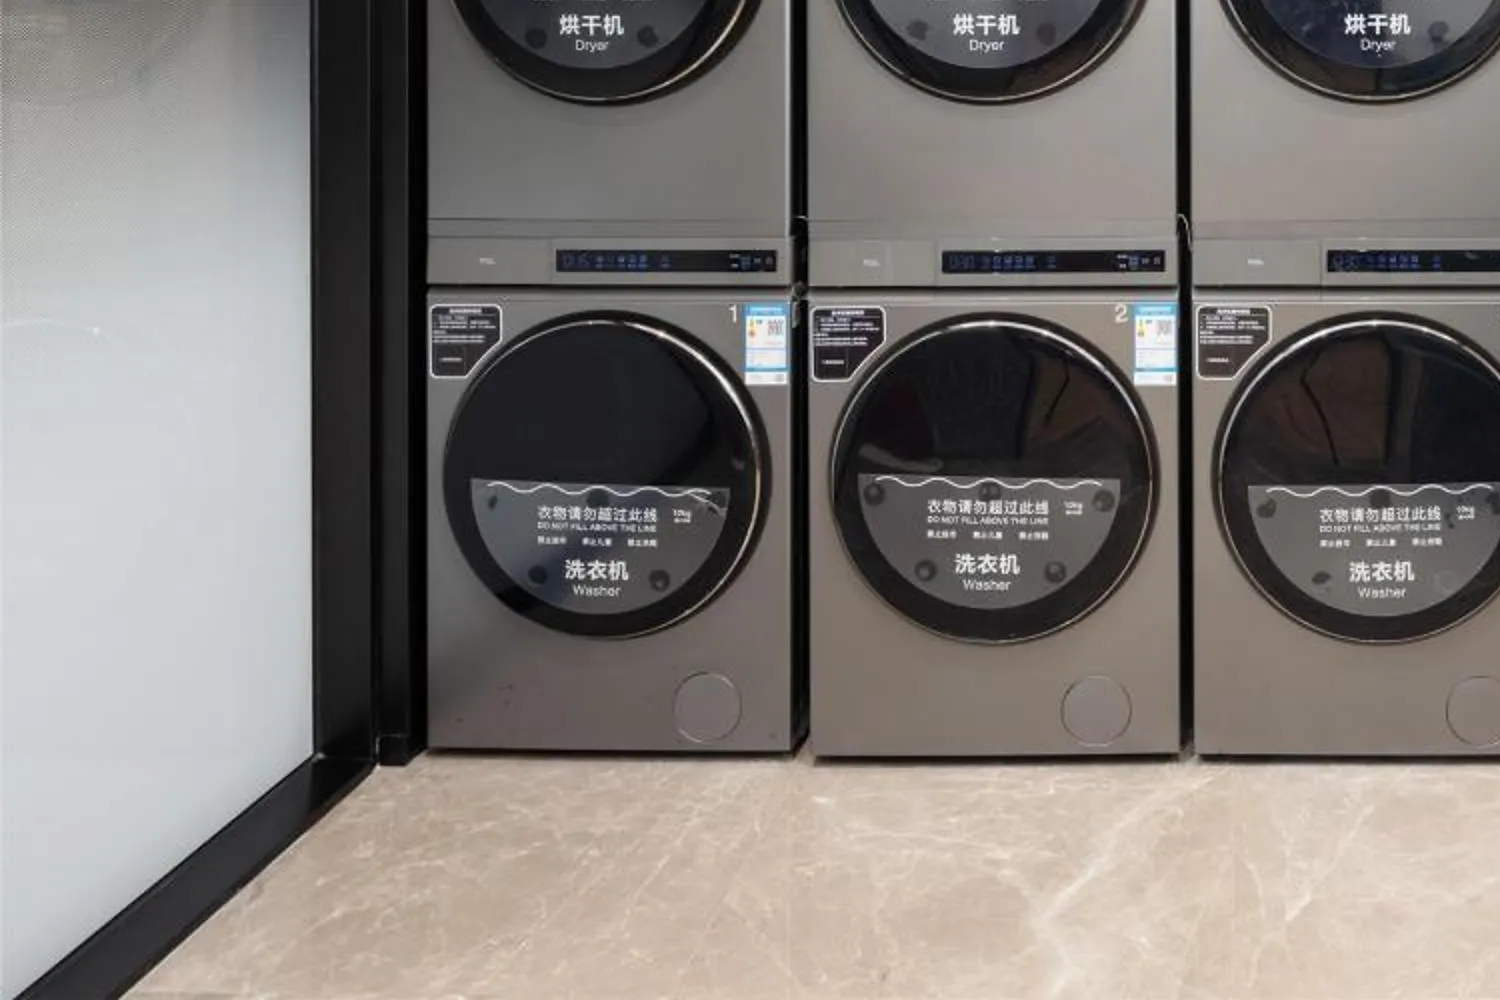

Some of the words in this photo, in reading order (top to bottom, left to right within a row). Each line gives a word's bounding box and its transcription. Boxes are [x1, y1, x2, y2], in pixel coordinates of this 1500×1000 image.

[560, 14, 624, 36] 烘干机
[952, 13, 1020, 36] 烘干机
[1344, 13, 1411, 35] 烘干机
[576, 40, 608, 52] Dryer
[970, 39, 1005, 53] Dryer
[1360, 38, 1396, 53] Dryer
[730, 305, 738, 323] 1
[1115, 304, 1128, 323] 2
[537, 506, 658, 522] 衣物请勿超过此线
[928, 500, 1048, 514] 衣物请勿超过此线
[1320, 506, 1440, 522] 衣物请勿超过此线
[564, 559, 630, 581] 洗衣机
[954, 553, 1020, 575] 洗衣机
[1350, 560, 1415, 582] 洗衣机
[572, 584, 622, 596] Washer
[962, 579, 1011, 591] Washer
[1358, 587, 1407, 600] Washer
